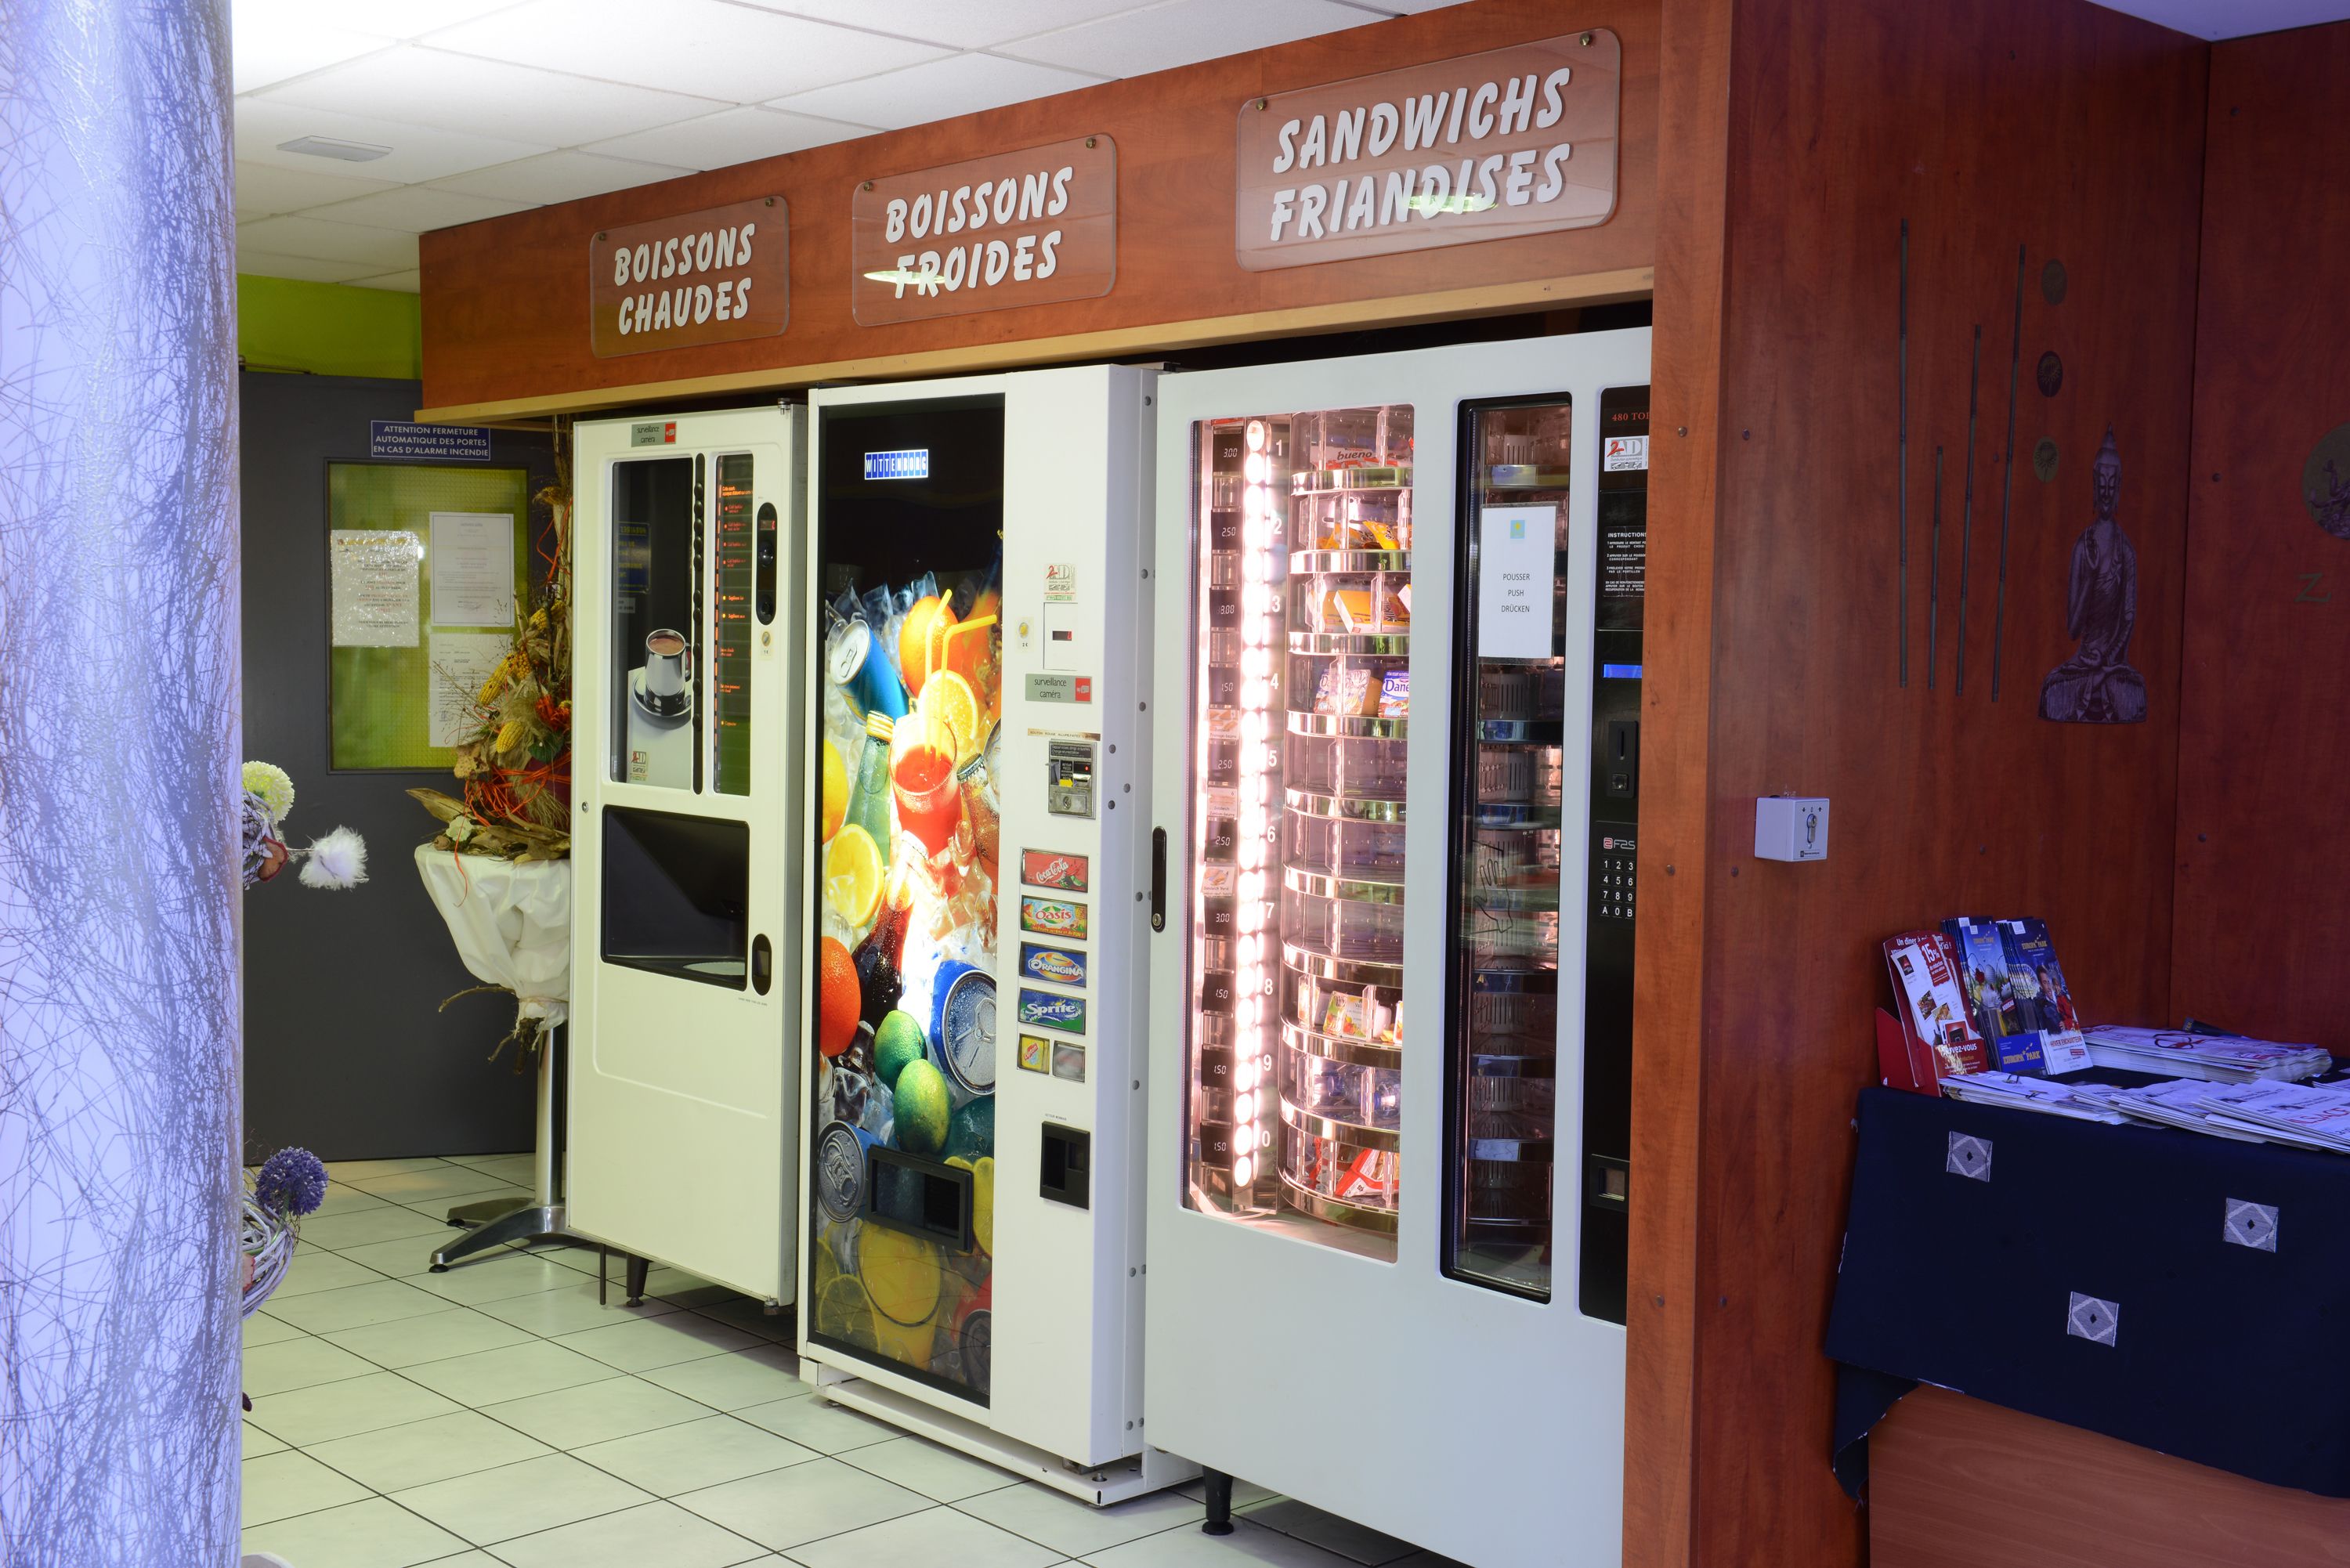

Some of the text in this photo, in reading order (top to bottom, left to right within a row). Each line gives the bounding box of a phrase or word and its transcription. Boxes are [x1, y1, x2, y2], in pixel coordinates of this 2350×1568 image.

[1272, 67, 1571, 174] SANDWICHS
[1270, 143, 1571, 242] FRIANDISES
[884, 165, 1073, 244] BOISSONS
[614, 222, 756, 287] BOISSONS
[895, 229, 1062, 299] FROIDES
[617, 276, 753, 336] CHAUDES
[1611, 413, 1629, 421] 480
[384, 425, 479, 436] ATTENTION FERMETURE
[375, 435, 437, 445] AUTOMATIQUE
[1275, 439, 1282, 456] 1
[405, 446, 448, 455] D'ALARME
[450, 448, 489, 457] INCENDIE
[1337, 450, 1372, 461] bueno
[866, 456, 927, 473] WITTENBORG
[1273, 518, 1282, 534] 2
[1271, 595, 1281, 612] 3
[1501, 603, 1530, 612] DRÜCKEN
[1034, 674, 1067, 687] surveillance
[1270, 673, 1279, 690] 4
[1039, 689, 1061, 699] caméra
[1268, 750, 1278, 768] 5
[1267, 826, 1276, 843] 6
[1604, 860, 1633, 871] 1 2 3
[1616, 876, 1621, 885] 5
[1628, 877, 1633, 886] 6
[1603, 891, 1632, 901] 7 8 9
[1035, 909, 1072, 920] Oasis
[1265, 902, 1275, 919] 7
[1602, 906, 1608, 915] A
[1627, 909, 1632, 917] B
[1029, 959, 1084, 977] ORANGINA
[1264, 978, 1274, 995] 8
[1025, 1001, 1077, 1017] Sprite
[1025, 1043, 1038, 1060] Lipton
[2026, 1050, 2041, 1060] PARK
[1263, 1054, 1272, 1071] 9
